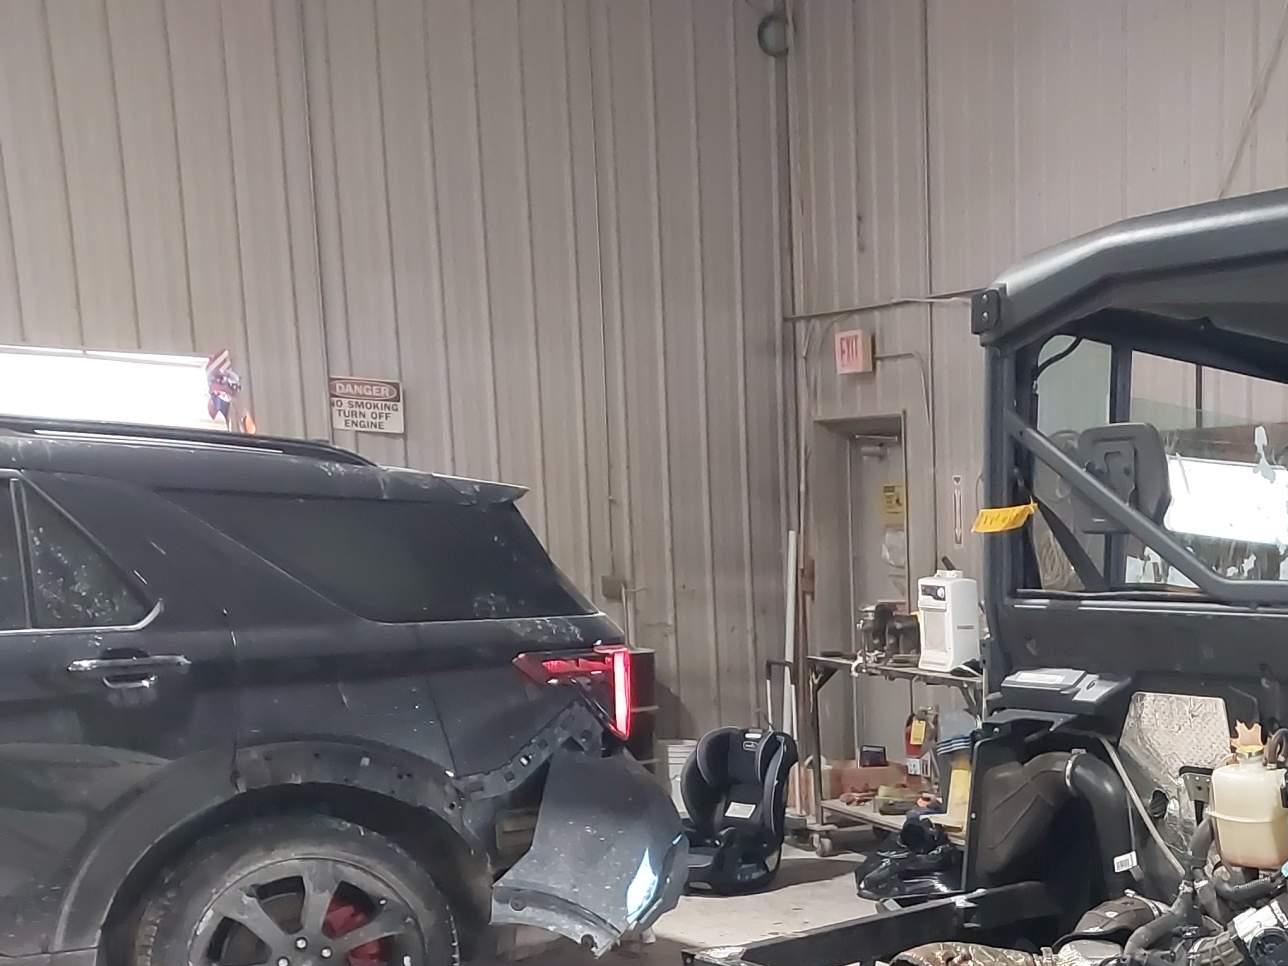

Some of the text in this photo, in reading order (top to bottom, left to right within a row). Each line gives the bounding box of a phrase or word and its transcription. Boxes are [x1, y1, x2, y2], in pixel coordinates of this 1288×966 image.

[336, 383, 389, 397] DANGER
[347, 400, 399, 412] SMOKING
[336, 409, 392, 421] TURN OFF
[344, 419, 385, 430] ENGINE
